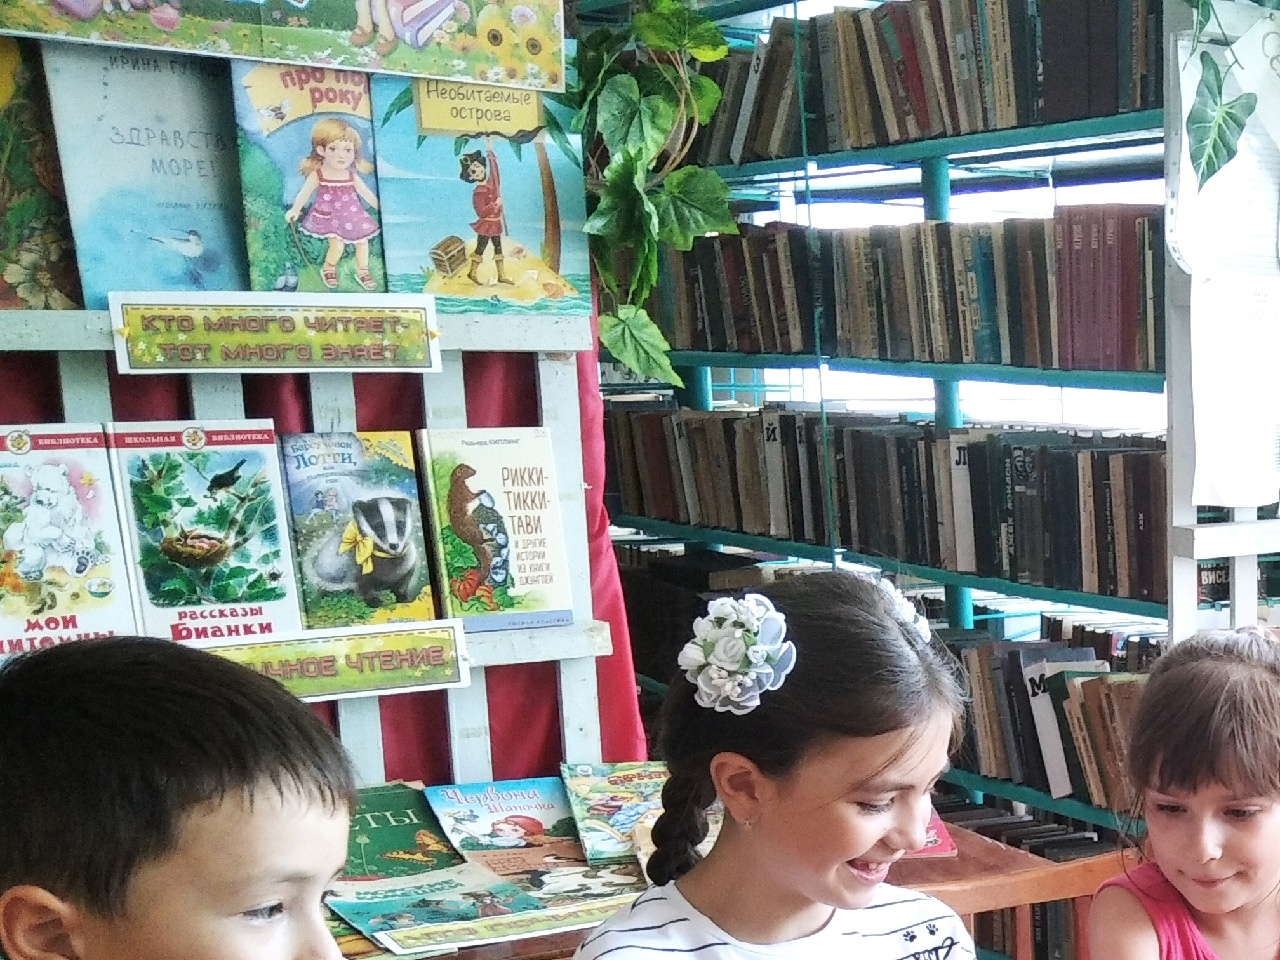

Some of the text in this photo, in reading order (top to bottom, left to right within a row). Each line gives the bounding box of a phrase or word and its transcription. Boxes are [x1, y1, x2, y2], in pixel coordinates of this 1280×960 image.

[309, 87, 362, 112] року
[426, 79, 531, 106] Необитаемые
[450, 104, 511, 125] острова
[140, 314, 195, 332] КТО
[203, 315, 296, 333] МНОГО
[158, 342, 401, 361] ТОТ МНОГО ЗНАЕТ
[38, 436, 99, 445] БИБЛИОТЕКА
[124, 433, 269, 444] ШКОЛЬНАЯ БИБЛИОТЕКА
[501, 466, 548, 487] РИККИ-
[503, 491, 550, 511] ТИККИ-
[507, 515, 542, 535] ТАВИ
[522, 538, 547, 549] ДРУГИЕ
[516, 551, 545, 561] ИСТОРИИ
[1201, 570, 1230, 585] ВИСЕ
[178, 606, 263, 621] рассказы
[170, 622, 273, 641] Бианки
[346, 646, 445, 671] ЧТЕНИЕ
[440, 786, 540, 806] Червона
[486, 801, 555, 815] Шапочка
